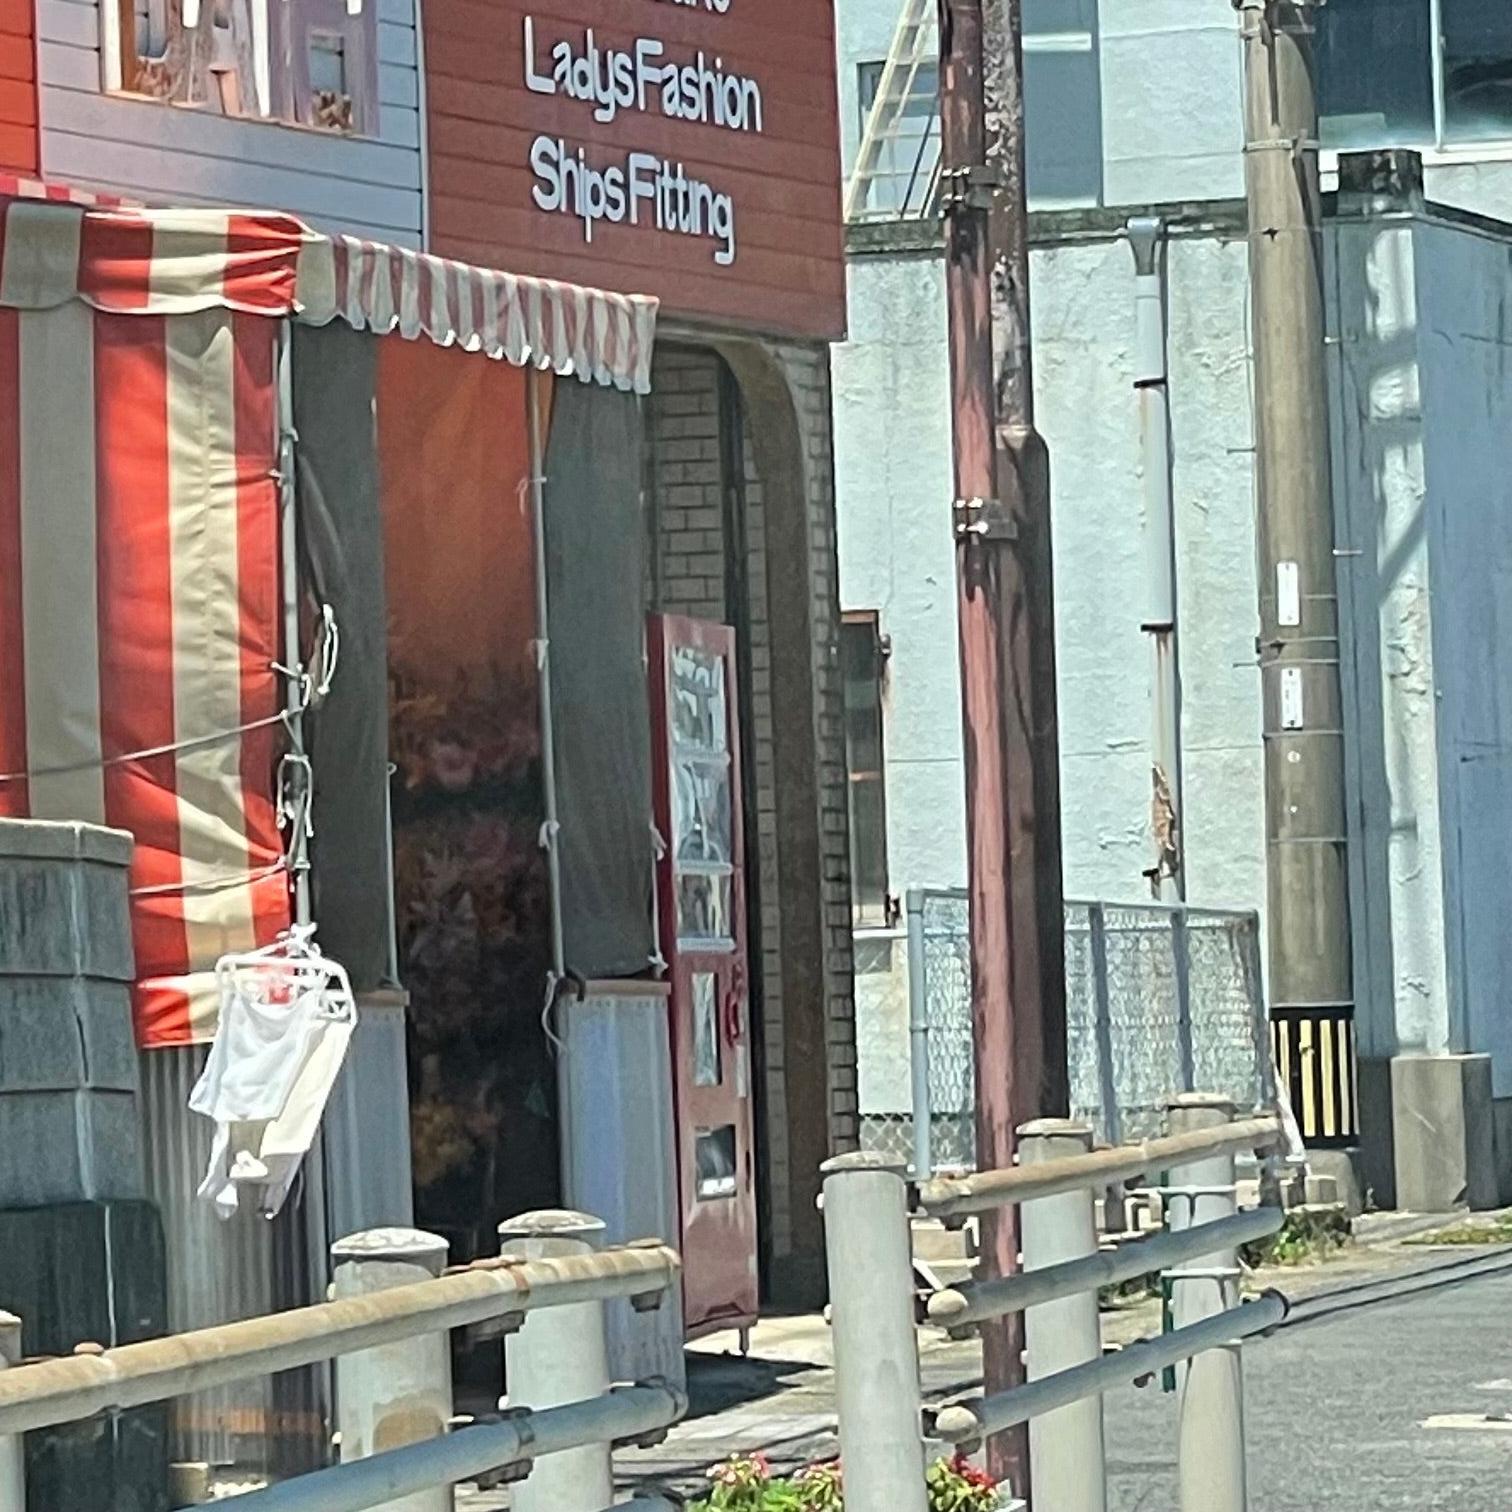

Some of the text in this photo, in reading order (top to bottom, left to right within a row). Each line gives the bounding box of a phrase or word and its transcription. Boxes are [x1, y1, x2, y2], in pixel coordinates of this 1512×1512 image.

[524, 15, 762, 132] Ladys Fashion
[530, 135, 735, 265] Ships Fitting
